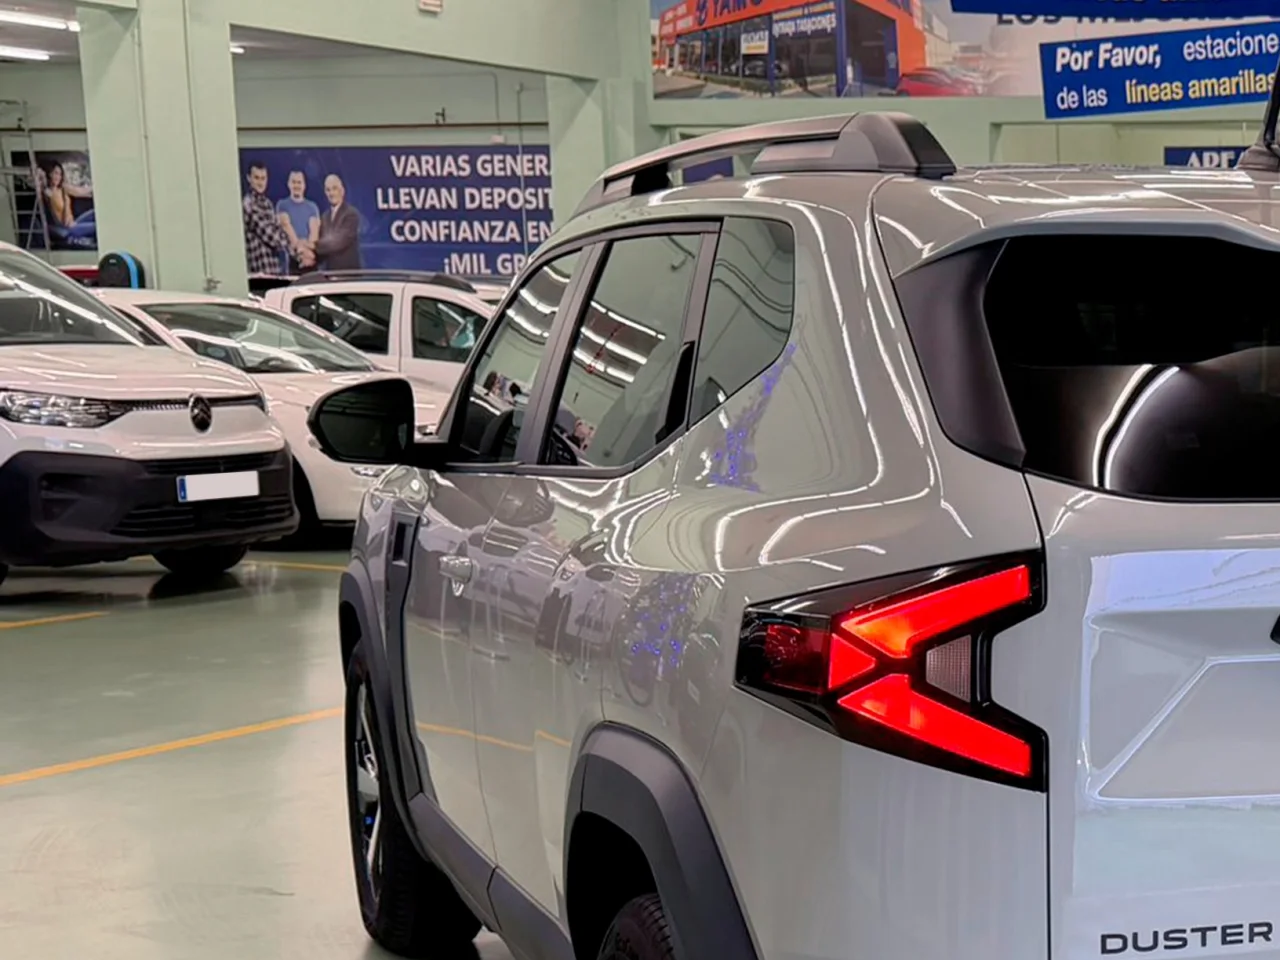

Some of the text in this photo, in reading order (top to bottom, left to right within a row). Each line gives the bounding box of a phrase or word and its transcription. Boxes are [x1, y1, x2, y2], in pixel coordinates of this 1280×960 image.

[1056, 45, 1092, 73] Por
[1098, 42, 1161, 70] Favor,
[1183, 31, 1279, 61] estacione
[1056, 89, 1079, 111] de
[1083, 86, 1108, 109] las
[1125, 77, 1183, 104] líneas
[390, 153, 551, 177] VARIAS GENER
[1187, 151, 1241, 168] ARE
[377, 187, 458, 210] LLEVAN
[390, 220, 521, 243] CONFIANZA
[1100, 921, 1273, 955] DUSTER
